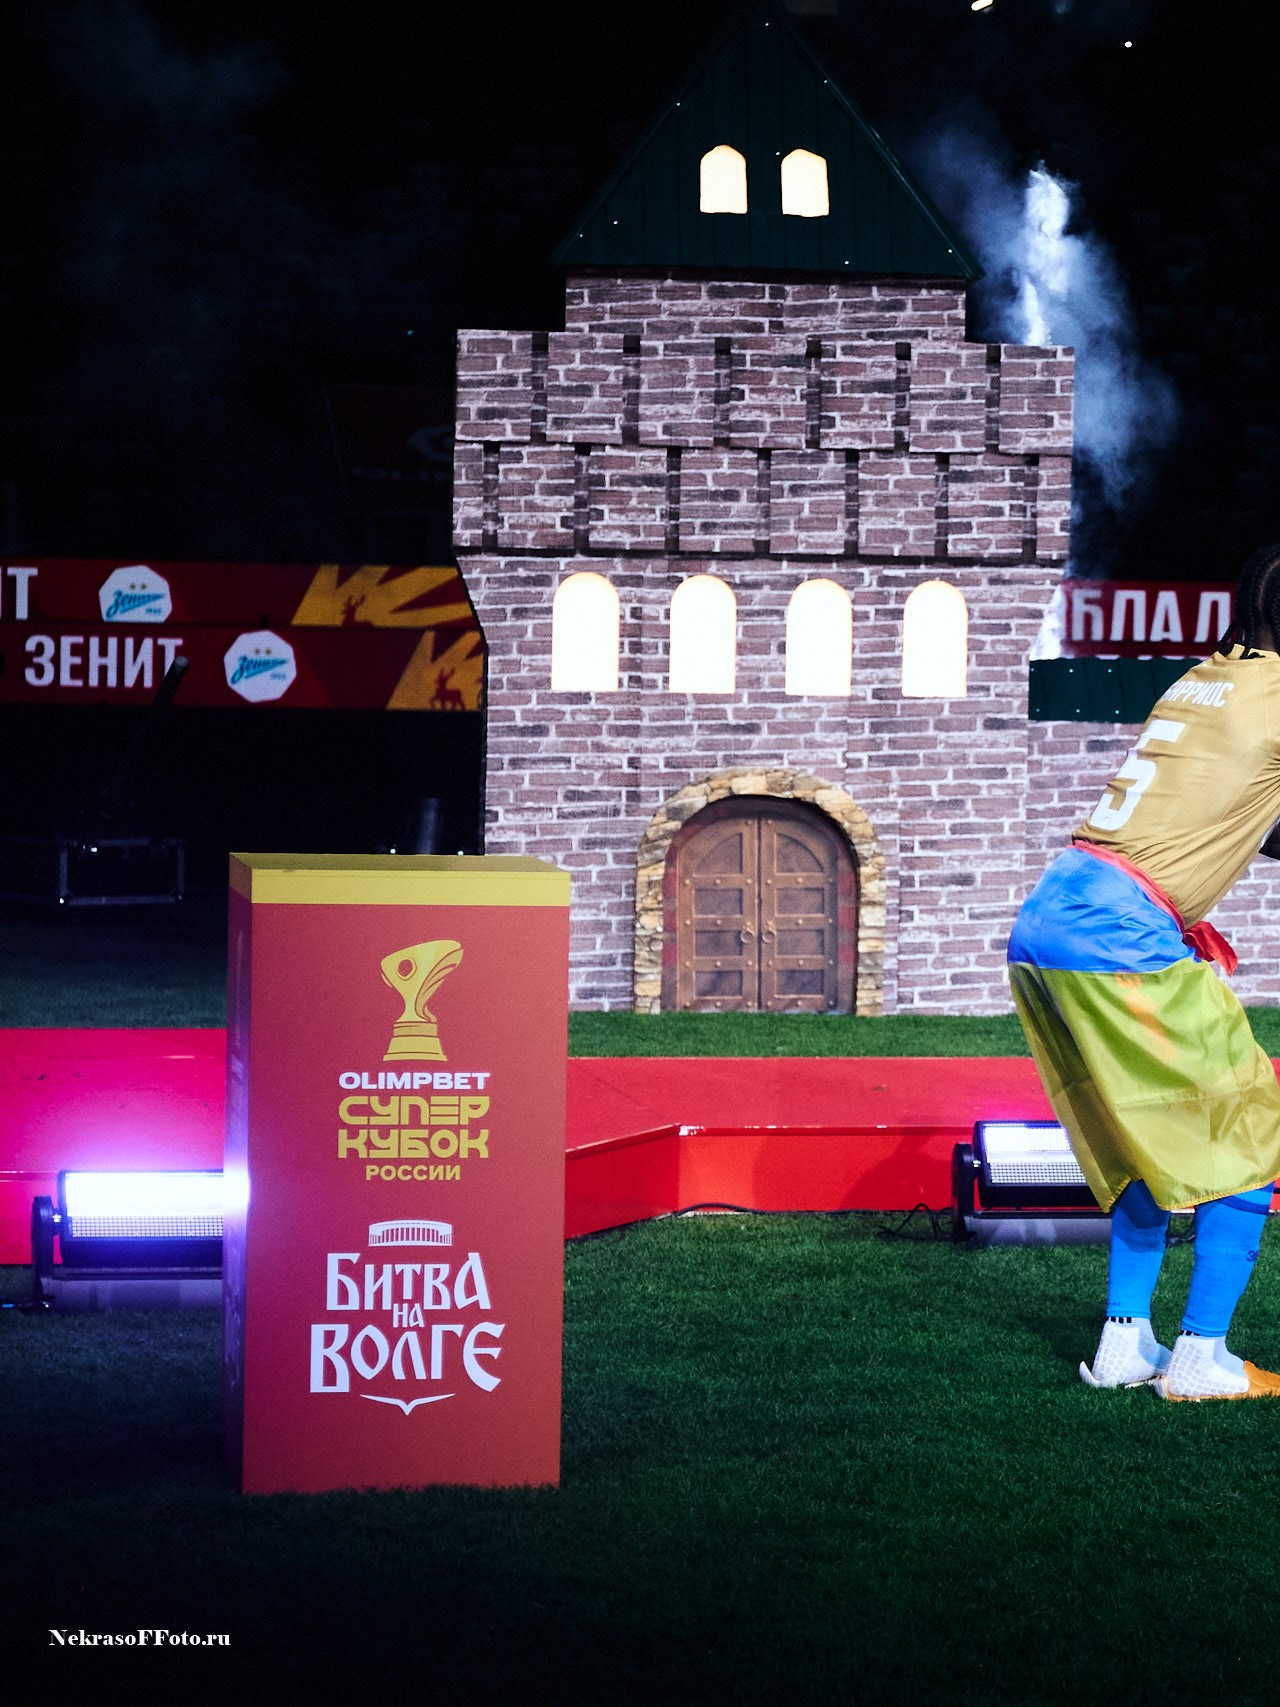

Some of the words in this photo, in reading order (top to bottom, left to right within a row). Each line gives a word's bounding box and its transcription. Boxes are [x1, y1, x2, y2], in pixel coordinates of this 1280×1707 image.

[25, 635, 183, 688] ЗЕНИТ
[1090, 719, 1186, 831] 5
[339, 1072, 490, 1090] OLIMPBET
[339, 1096, 490, 1125] СУПЕР
[338, 1129, 489, 1158] КУБОК
[366, 1165, 460, 1180] РОССИИ
